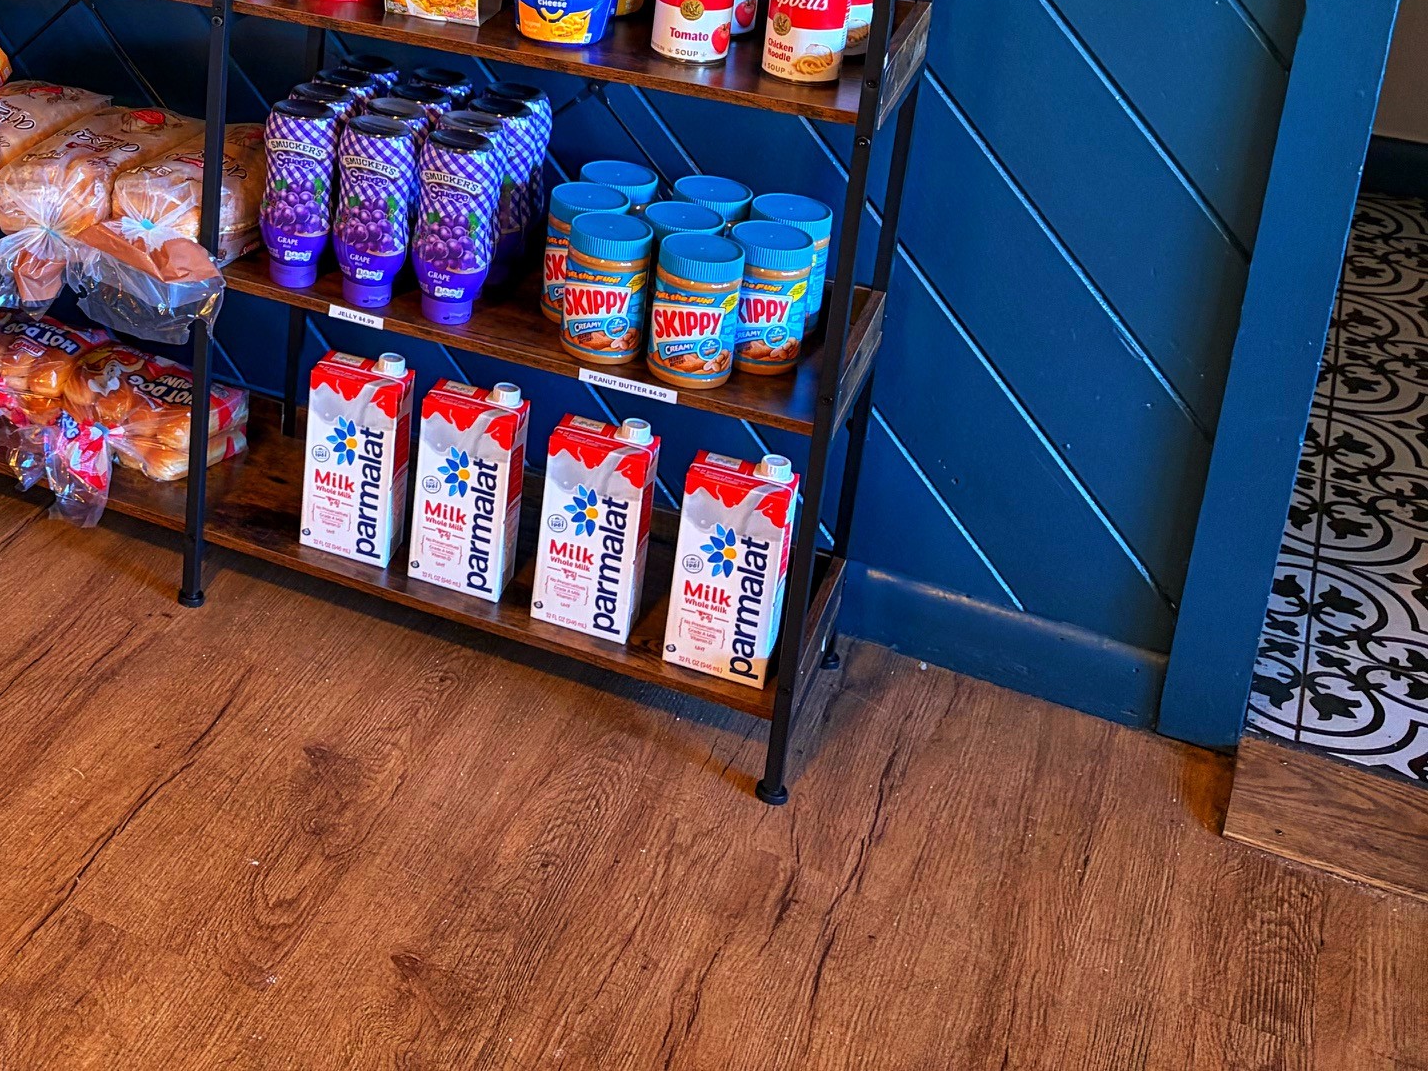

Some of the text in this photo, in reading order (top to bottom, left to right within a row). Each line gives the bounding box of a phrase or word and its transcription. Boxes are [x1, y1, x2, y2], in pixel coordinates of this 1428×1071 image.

[669, 26, 709, 42] Tomato
[675, 48, 699, 58] SOUP
[768, 38, 794, 53] Chicken
[767, 48, 791, 62] Noodle
[767, 63, 785, 74] SOUP
[271, 140, 325, 158] SMUCKER'S
[276, 153, 315, 171] Squeeze
[345, 156, 397, 177] SMUCKER'S
[350, 169, 388, 187] Squeeze
[423, 172, 480, 194] SMUCKER'S
[430, 185, 469, 203] Squeeze
[278, 236, 298, 246] GRAPE
[349, 253, 370, 264] GRAPE
[427, 270, 450, 282] GRAPE
[565, 288, 628, 316] SKIPPY
[737, 298, 789, 324] KIPPY
[337, 310, 375, 325] JELLY $4.99
[654, 309, 721, 338] SKIPPY
[574, 322, 602, 332] CREAMY
[737, 330, 761, 339] REAMY
[3, 322, 78, 353] HOT DOG
[665, 344, 694, 355] CREAMY
[129, 376, 165, 395] DOG
[588, 373, 667, 399] PEANUT BUTTER $4.99
[314, 468, 355, 493] Milk
[316, 484, 352, 500] Whole Milk
[355, 426, 384, 560] parmalat
[425, 500, 467, 525] Milk
[426, 516, 464, 532] Whole Milk
[467, 458, 499, 594] parmalat
[549, 539, 594, 565] Milk
[550, 555, 591, 572] Whole Milk
[593, 497, 629, 635] parmalat
[684, 580, 731, 608] Milk
[684, 597, 727, 615] Whole Milk
[729, 537, 770, 680] parmalat
